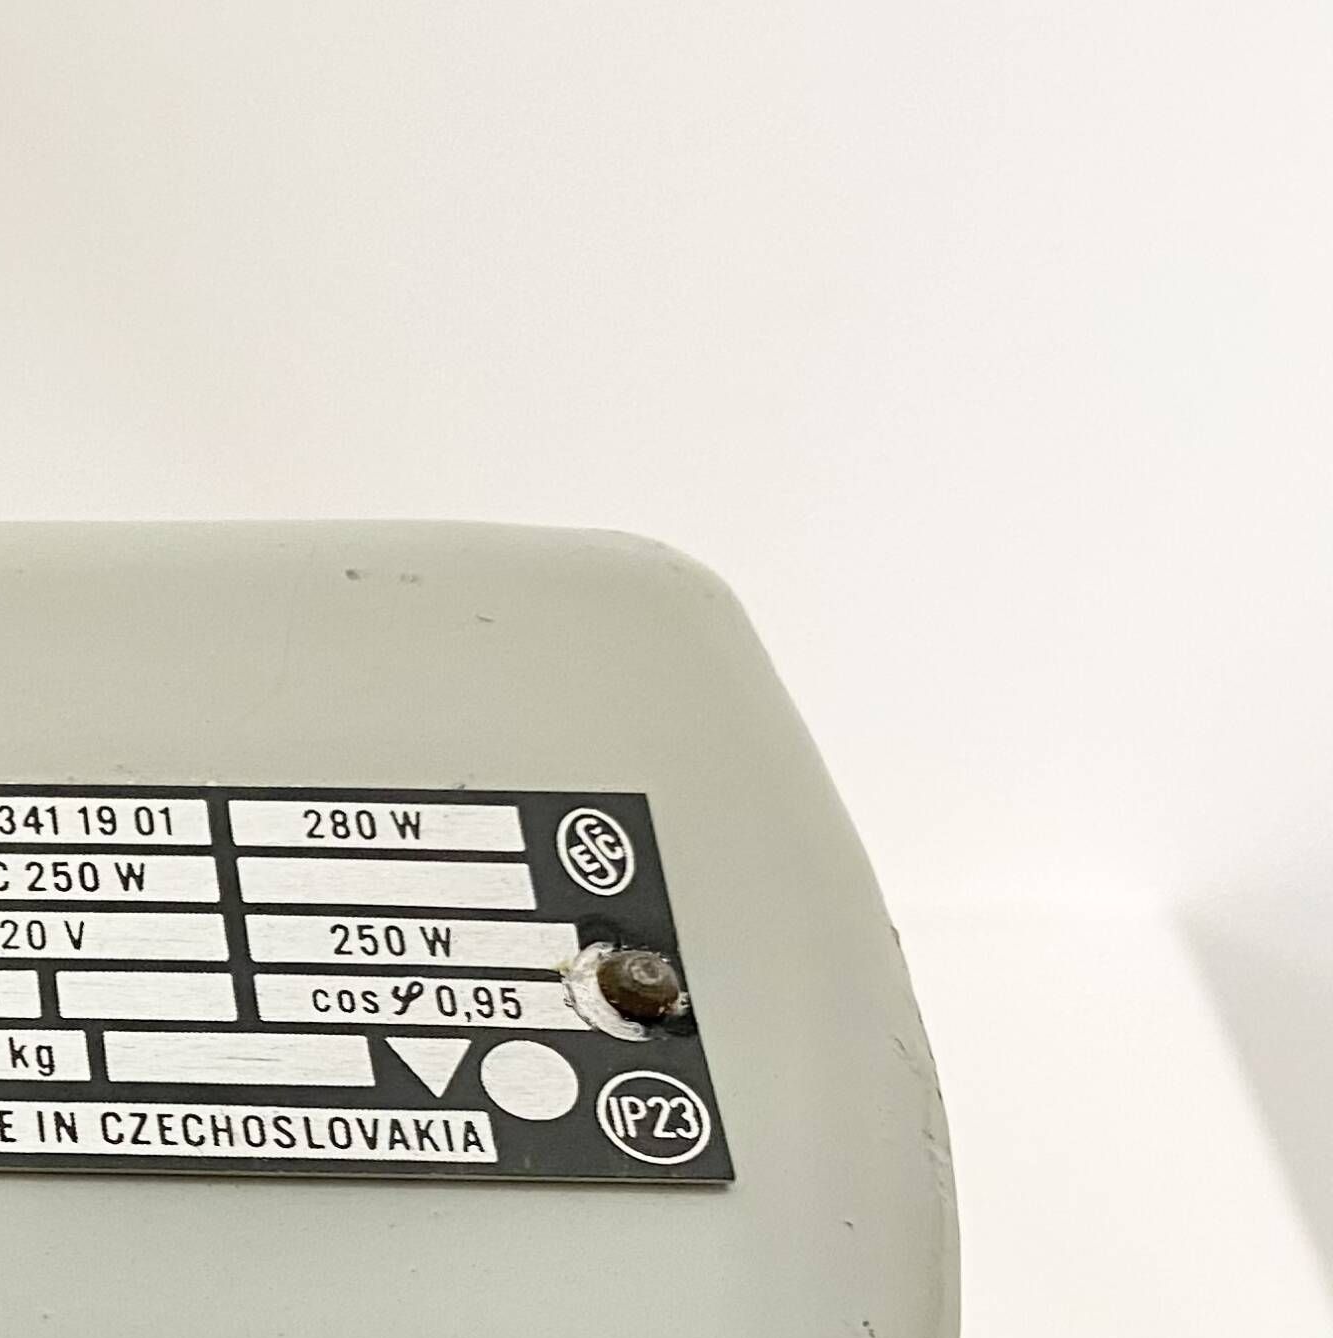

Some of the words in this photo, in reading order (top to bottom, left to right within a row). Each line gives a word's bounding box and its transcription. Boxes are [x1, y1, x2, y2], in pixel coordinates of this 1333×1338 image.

[76, 805, 118, 837] 19
[134, 806, 174, 837] 01
[303, 808, 377, 840] 280
[389, 810, 422, 841] W
[25, 860, 100, 893] 250
[114, 861, 146, 893] W
[63, 919, 86, 951] V
[329, 923, 407, 957] 250
[418, 925, 452, 958] W
[435, 984, 523, 1023] 0,95
[8, 1035, 57, 1076] kg
[36, 1109, 80, 1145] IN
[100, 1111, 486, 1154] CZECHOSLOVAKIA
[606, 1095, 698, 1140] IP23
